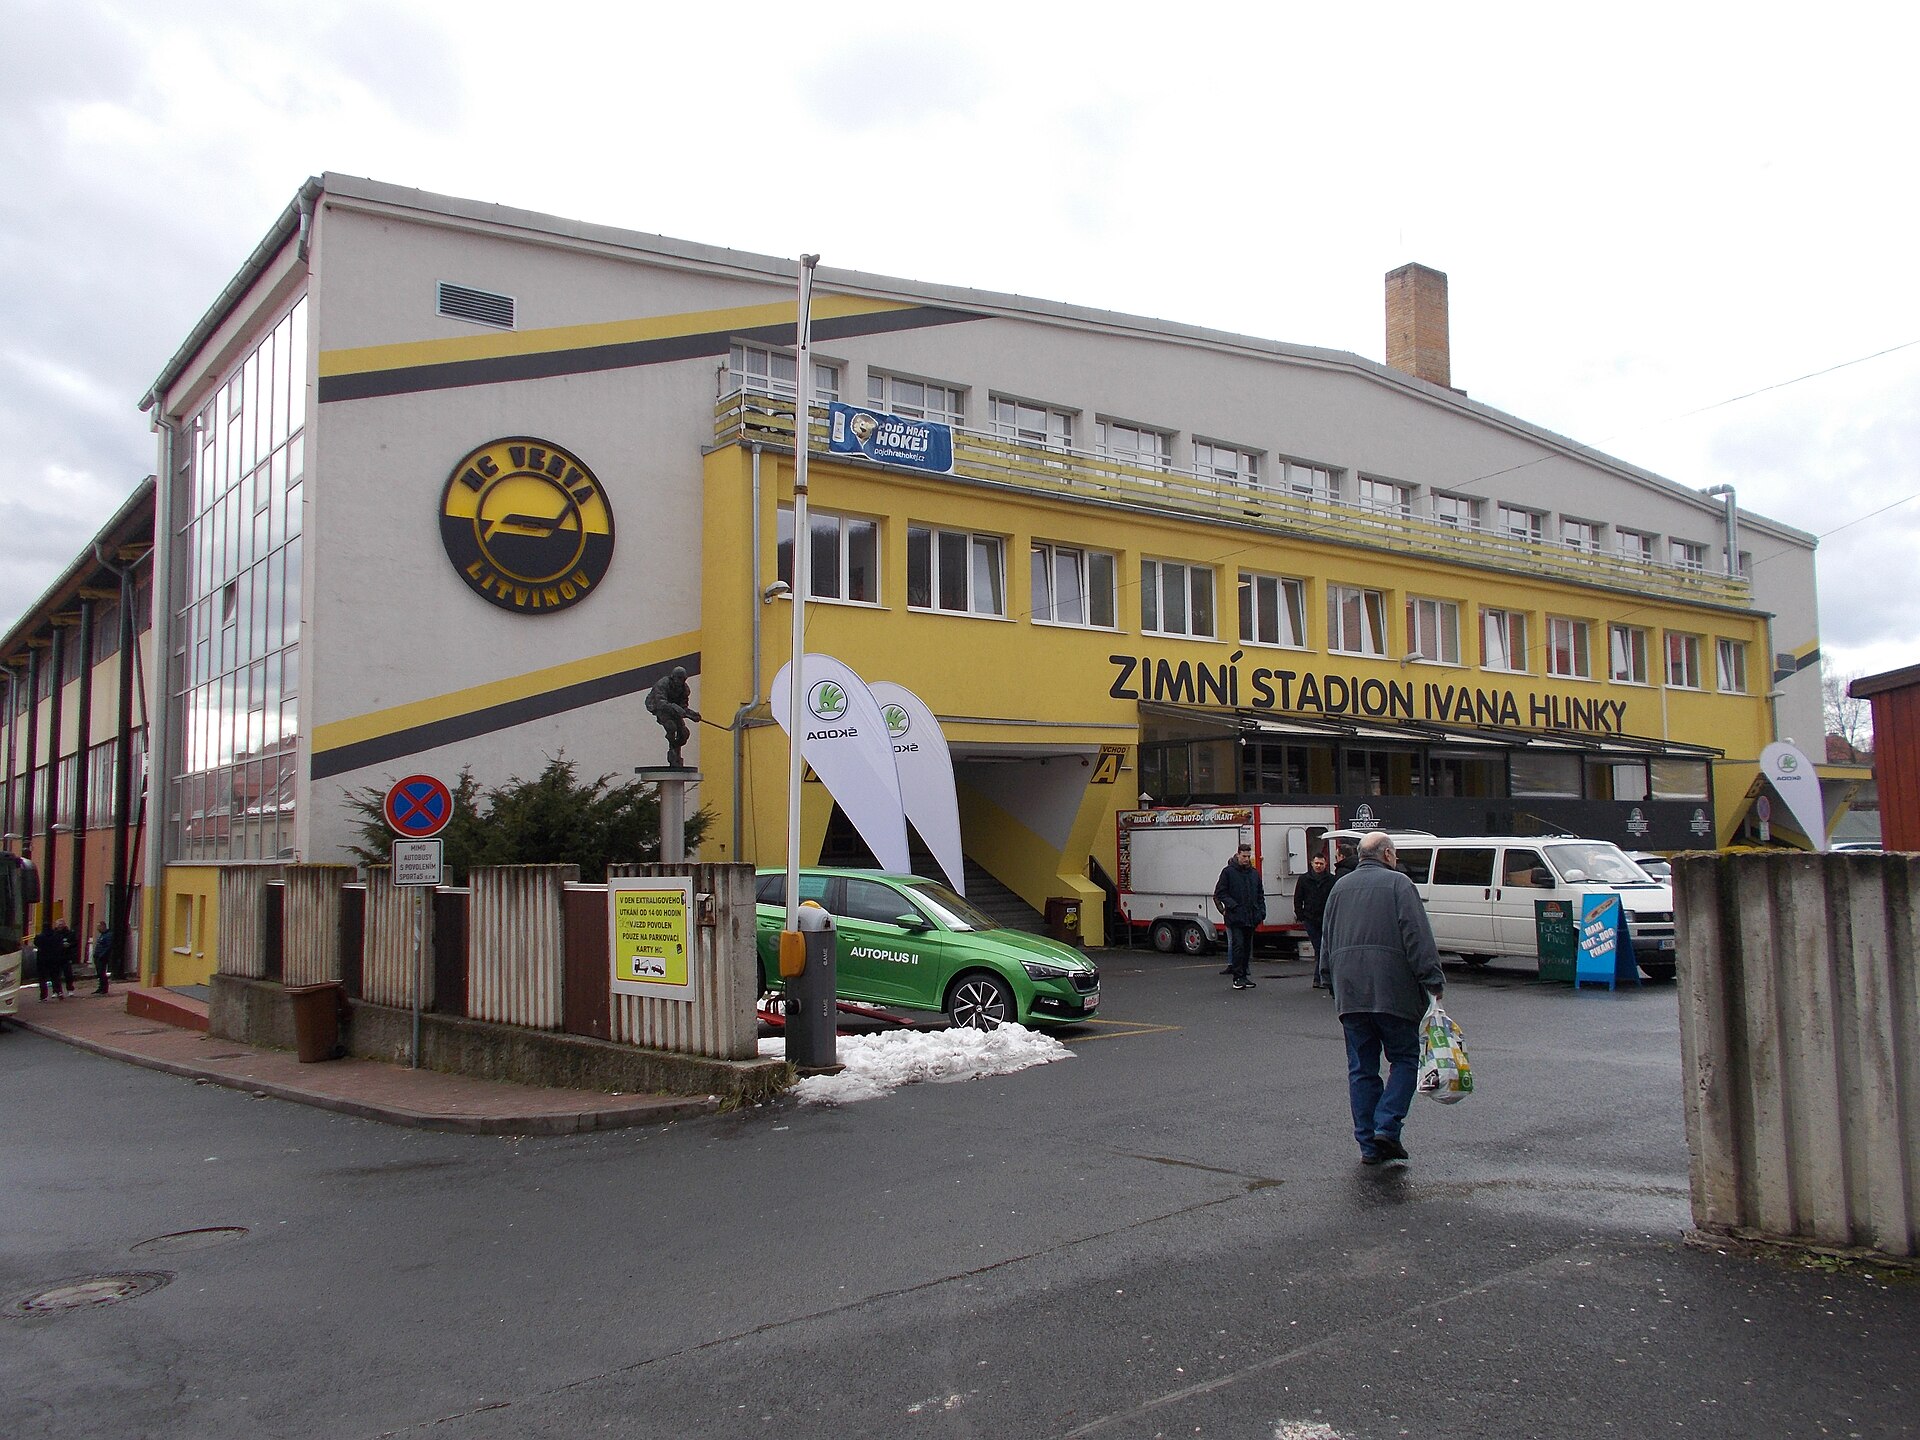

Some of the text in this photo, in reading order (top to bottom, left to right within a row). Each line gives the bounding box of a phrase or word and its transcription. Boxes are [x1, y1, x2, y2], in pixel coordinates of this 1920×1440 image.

[905, 426, 929, 439] HRÁT
[875, 430, 928, 452] HOKEJ
[873, 448, 925, 462] pojdhrathokej.cz
[460, 446, 595, 506] HC VERVA
[466, 560, 590, 608] LITVINOV
[1109, 650, 1627, 732] ZIMNÍ STADION IVANA HLINKY
[1102, 746, 1127, 754] VCHOD
[1091, 754, 1117, 783] A
[625, 896, 635, 904] DEN
[663, 909, 682, 917] HODIN
[647, 921, 672, 929] POVOLEN
[1585, 921, 1604, 936] MAXI
[622, 932, 639, 940] POUZE
[640, 933, 648, 941] NA
[636, 945, 653, 953] KARTY
[850, 946, 919, 965] AUTOPLUS II
[1590, 940, 1615, 958] PIKANT
